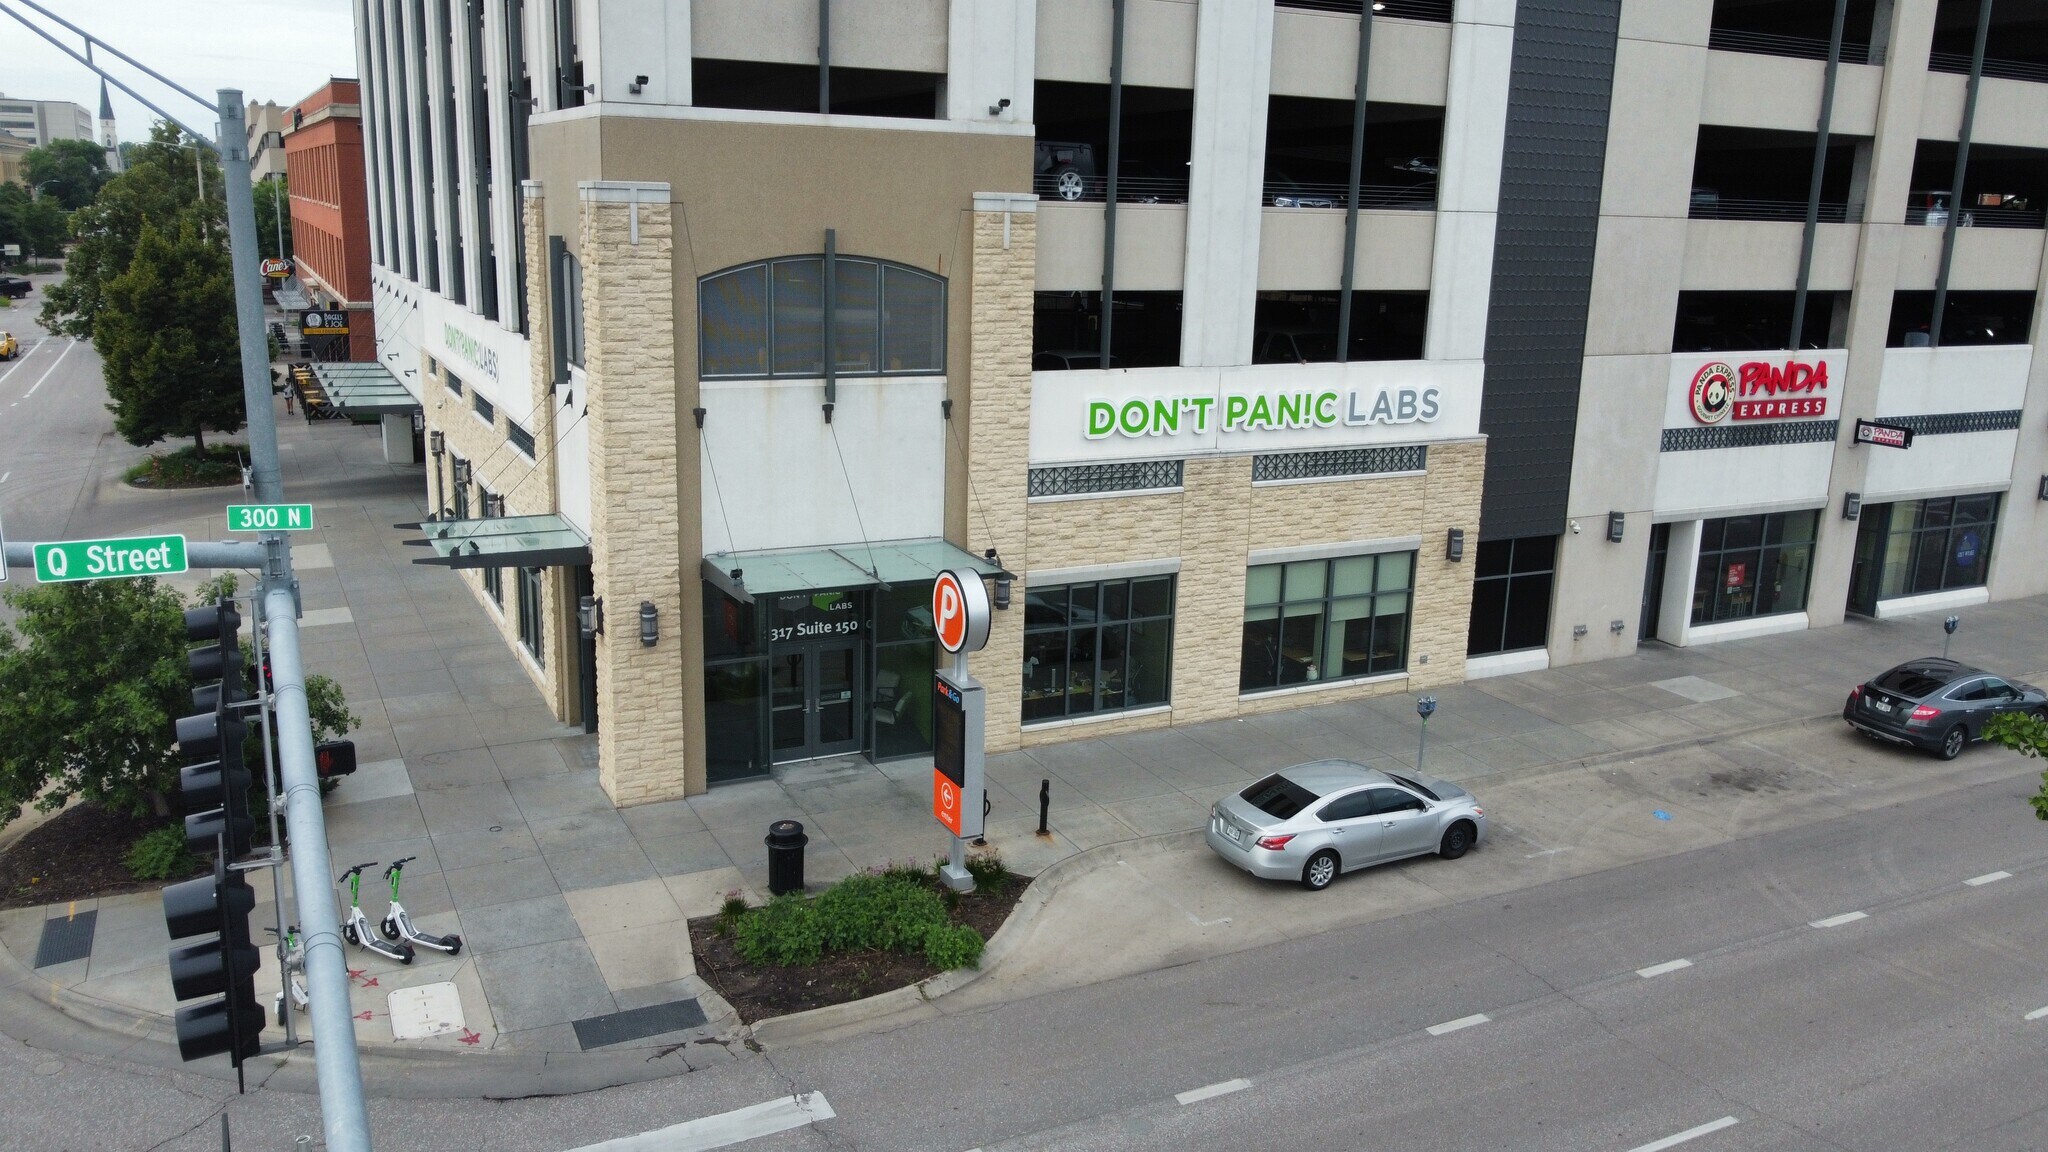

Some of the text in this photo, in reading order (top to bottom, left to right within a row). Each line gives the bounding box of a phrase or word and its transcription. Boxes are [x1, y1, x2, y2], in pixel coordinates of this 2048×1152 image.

[1695, 365, 1735, 396] PANDA EXPRESS
[1739, 360, 1828, 396] PANDA
[1089, 397, 1214, 435] DON'T
[1349, 388, 1439, 421] LABS
[1740, 401, 1822, 417] EXPRESS
[1874, 427, 1904, 440] PANDA
[240, 508, 301, 528] 300 N
[47, 542, 171, 577] Q Street
[829, 602, 853, 611] LABS
[939, 584, 958, 635] P
[771, 621, 858, 641] 317 Suite 150
